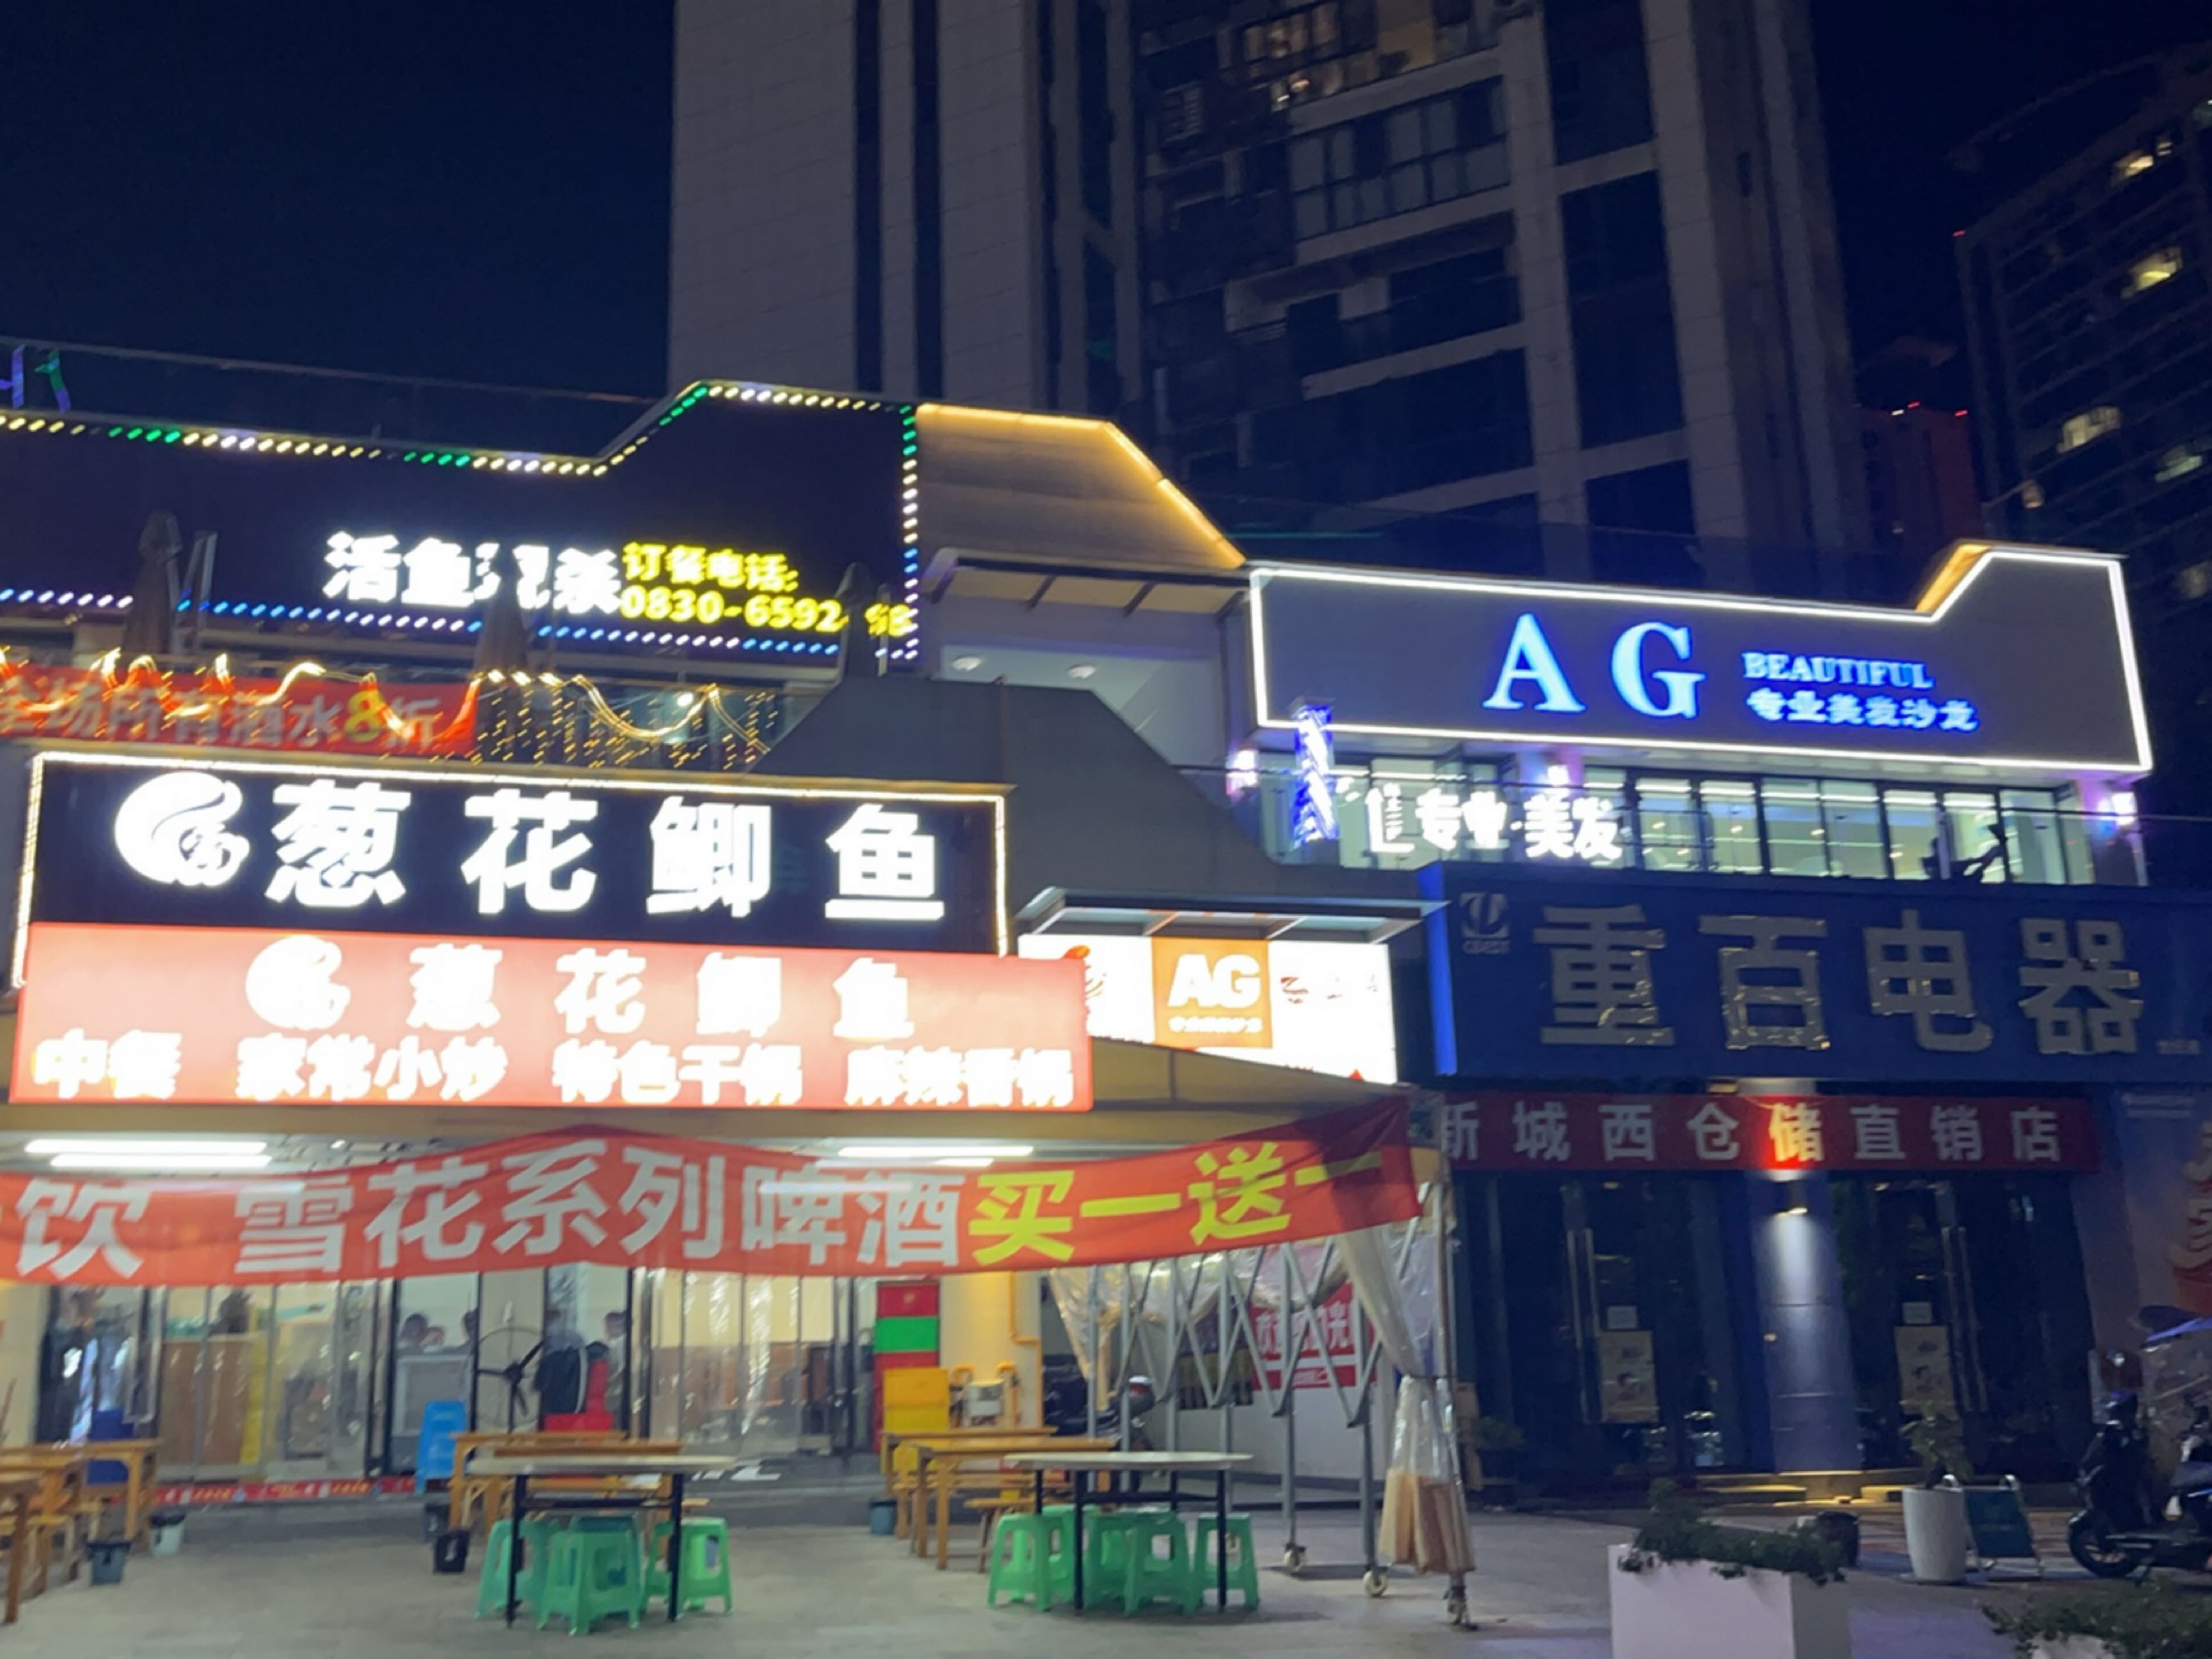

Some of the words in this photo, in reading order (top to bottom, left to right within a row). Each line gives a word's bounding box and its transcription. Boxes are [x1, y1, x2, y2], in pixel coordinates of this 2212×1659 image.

[1741, 652, 1935, 689] BEAUTIFUL
[264, 778, 945, 920] 葱花鲫鱼
[406, 942, 915, 1039] 葱花鲫鱼
[1167, 954, 1261, 1009] AG
[1533, 904, 2144, 1054] 重百电器
